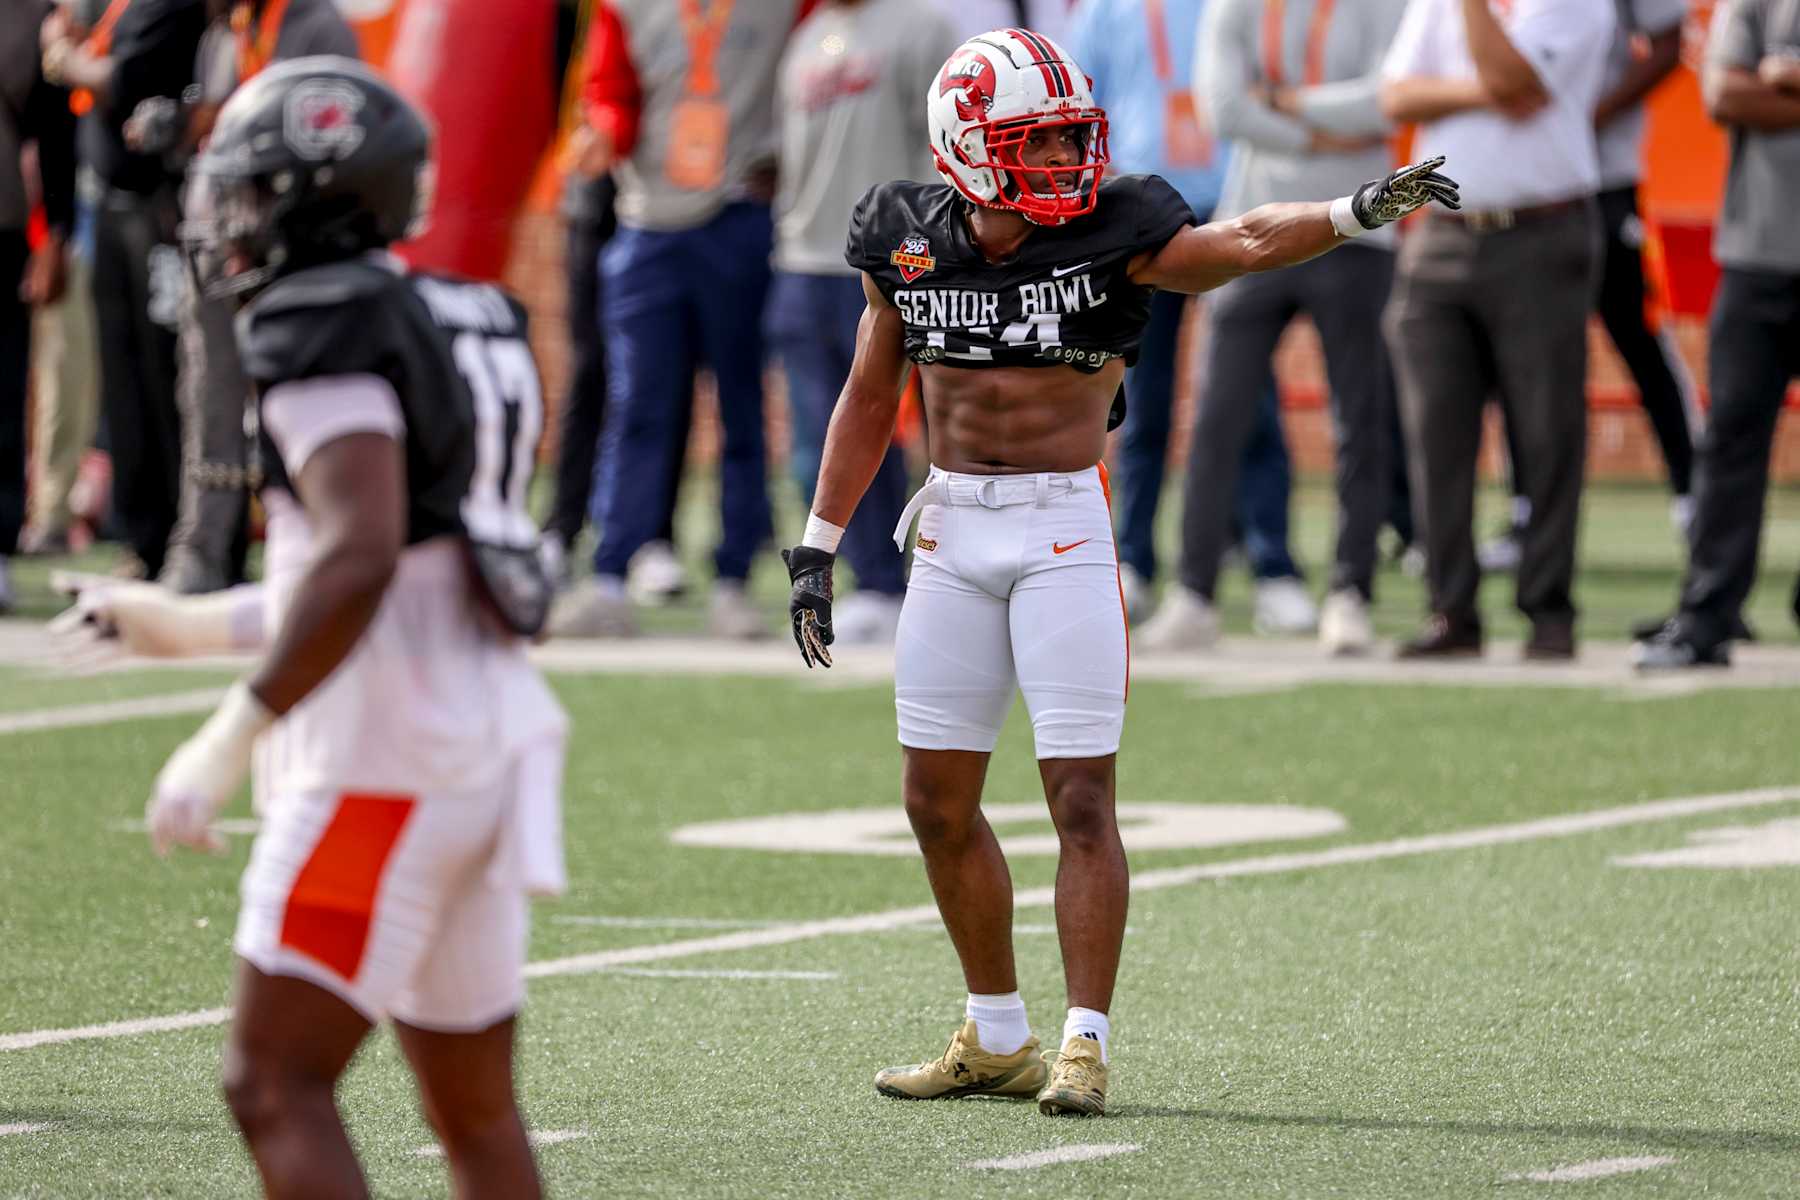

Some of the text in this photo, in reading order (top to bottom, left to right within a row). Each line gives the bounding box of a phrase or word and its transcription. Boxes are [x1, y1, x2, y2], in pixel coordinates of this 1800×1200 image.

[894, 253, 932, 267] PANINI
[894, 274, 1107, 328] SENIOR BOWL
